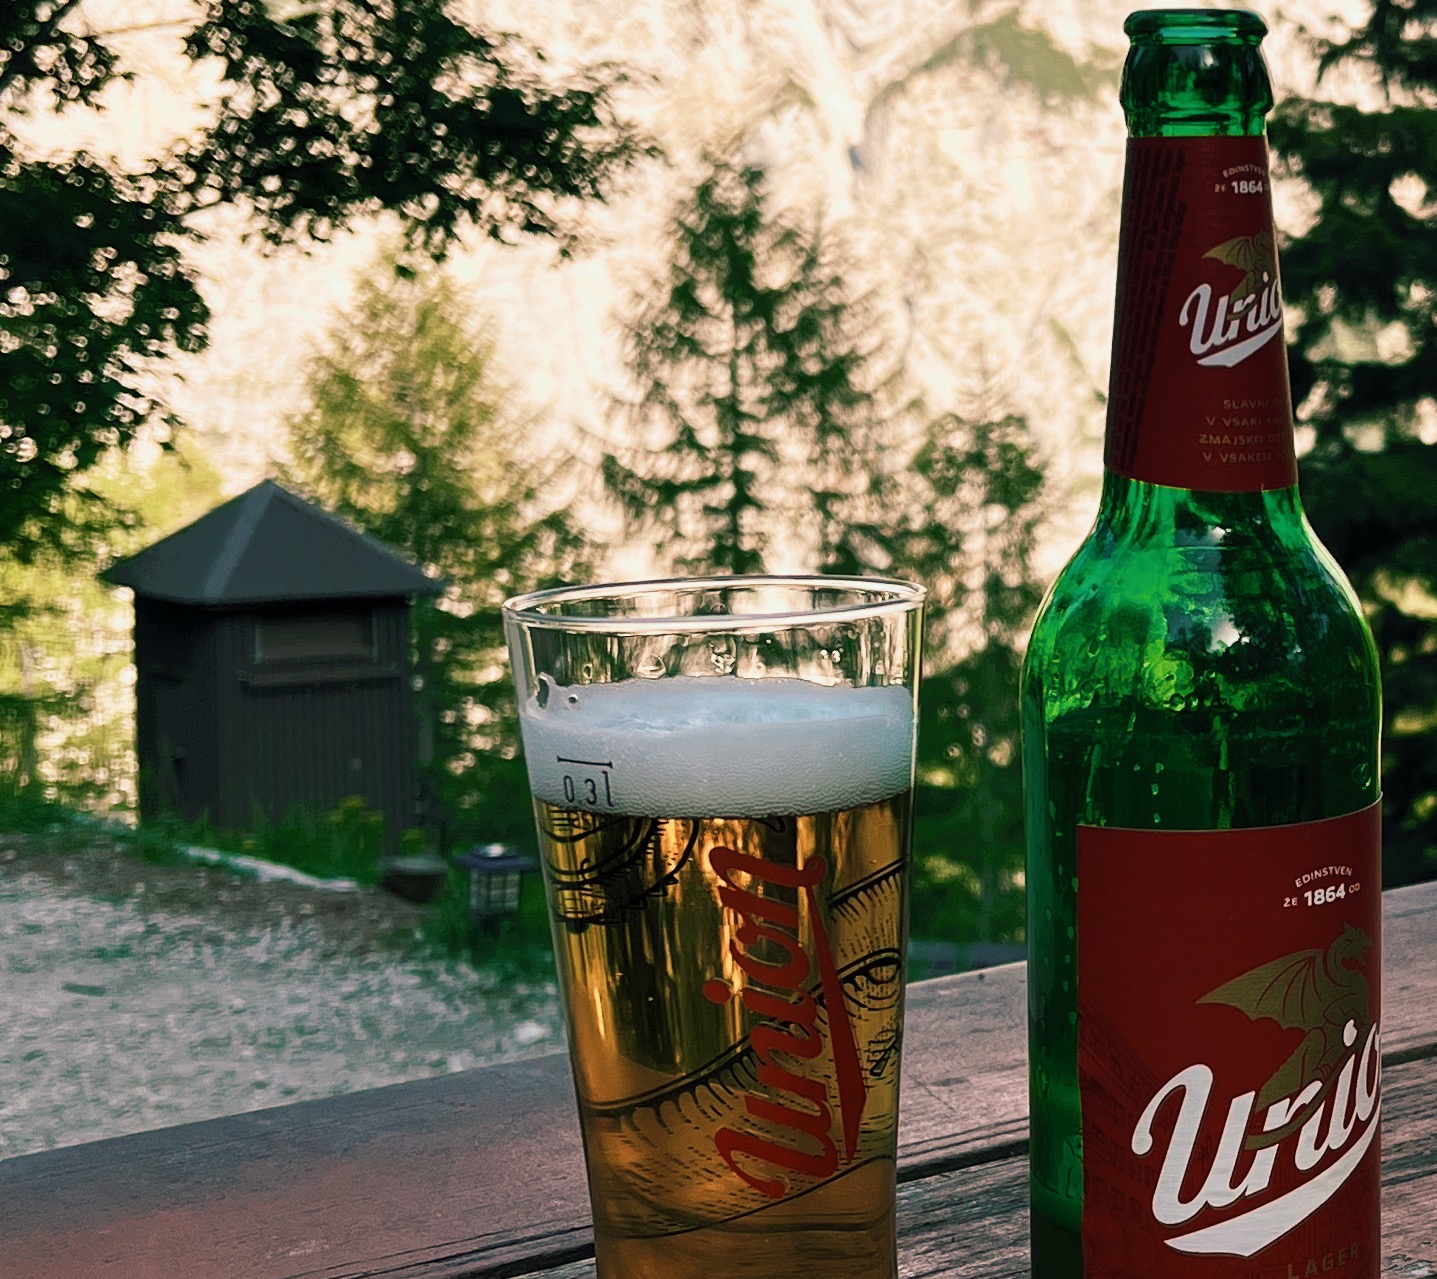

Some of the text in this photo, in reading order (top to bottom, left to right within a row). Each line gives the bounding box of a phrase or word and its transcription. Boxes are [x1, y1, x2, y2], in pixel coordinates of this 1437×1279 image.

[1231, 179, 1263, 195] 1864
[1178, 271, 1282, 355] Unio
[1204, 415, 1216, 426] V
[1201, 451, 1212, 463] V
[1294, 865, 1353, 888] EDINSTVEN
[1303, 882, 1346, 907] 1864
[702, 846, 839, 1199] Union
[1131, 1018, 1380, 1226] Unio
